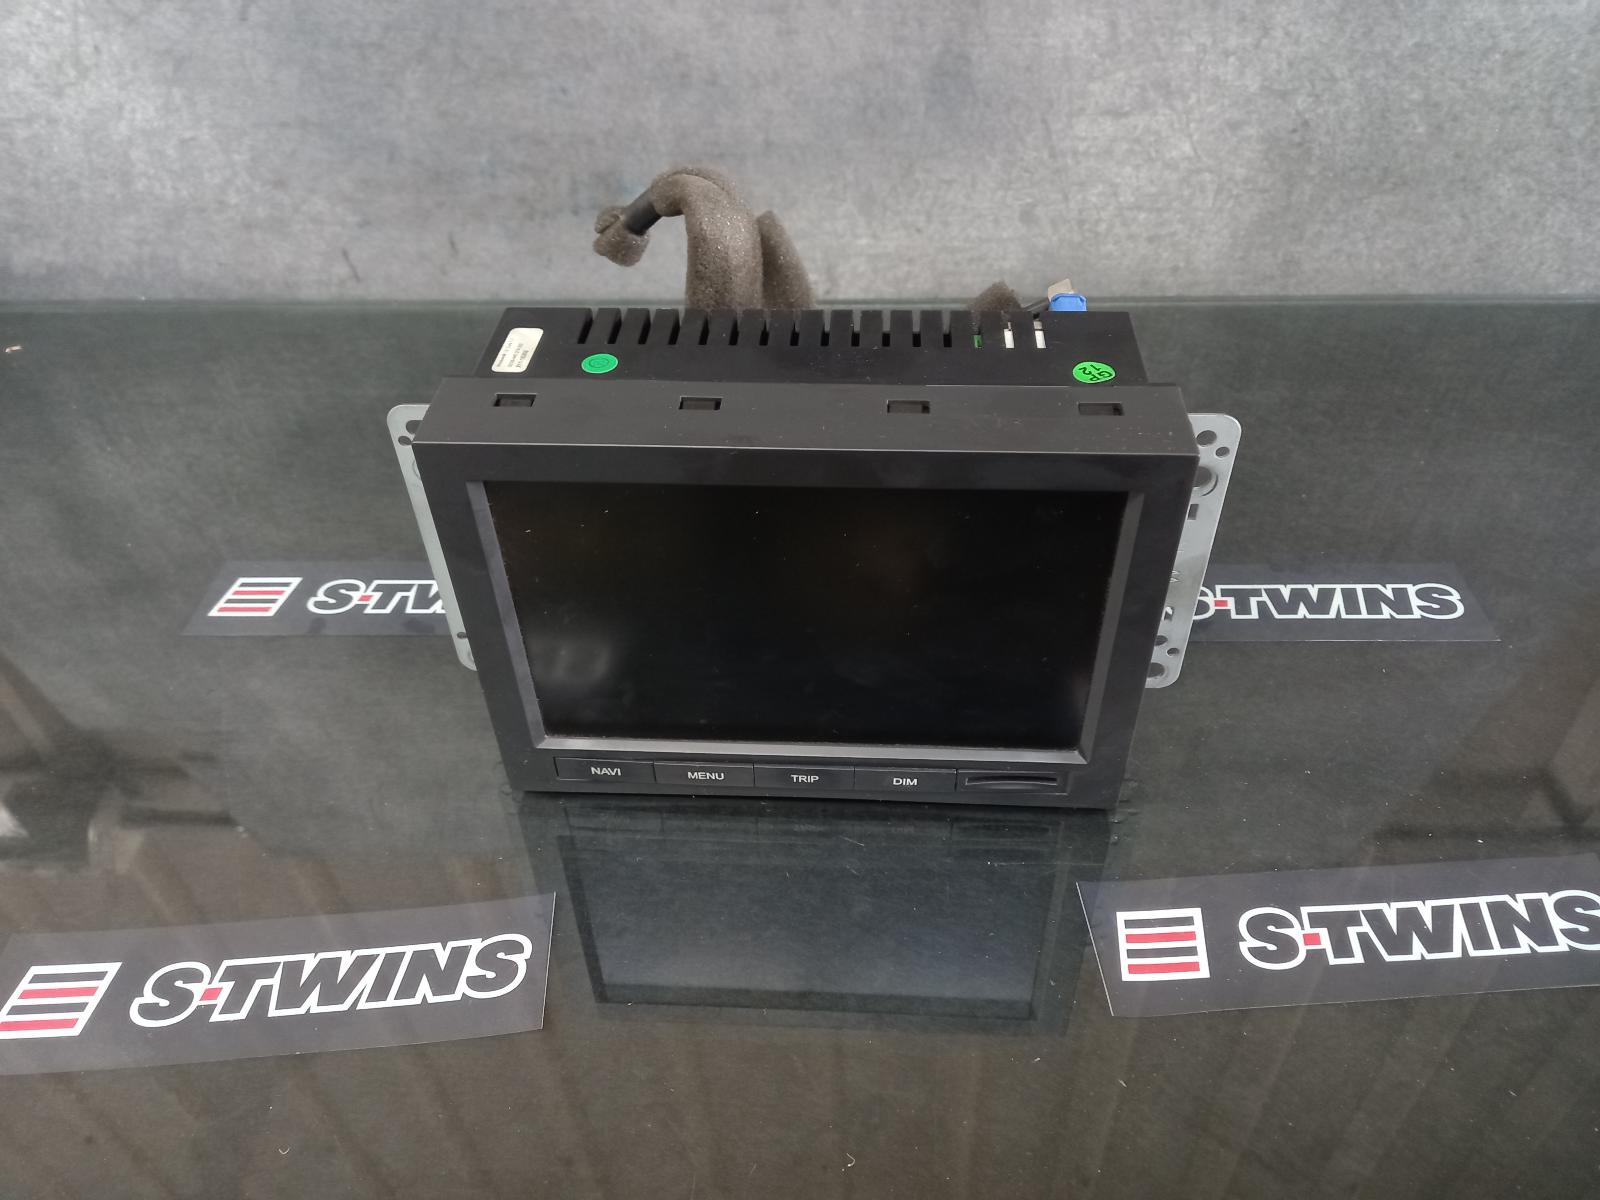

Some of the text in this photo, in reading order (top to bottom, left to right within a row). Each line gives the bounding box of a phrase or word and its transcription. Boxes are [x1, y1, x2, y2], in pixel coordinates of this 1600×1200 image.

[590, 766, 622, 777] NAVI
[687, 771, 725, 781] MENU
[791, 774, 819, 784] TRIP
[892, 777, 919, 787] DIM
[1239, 889, 1600, 971] S-TWINS
[130, 933, 533, 1027] S-TWINS
